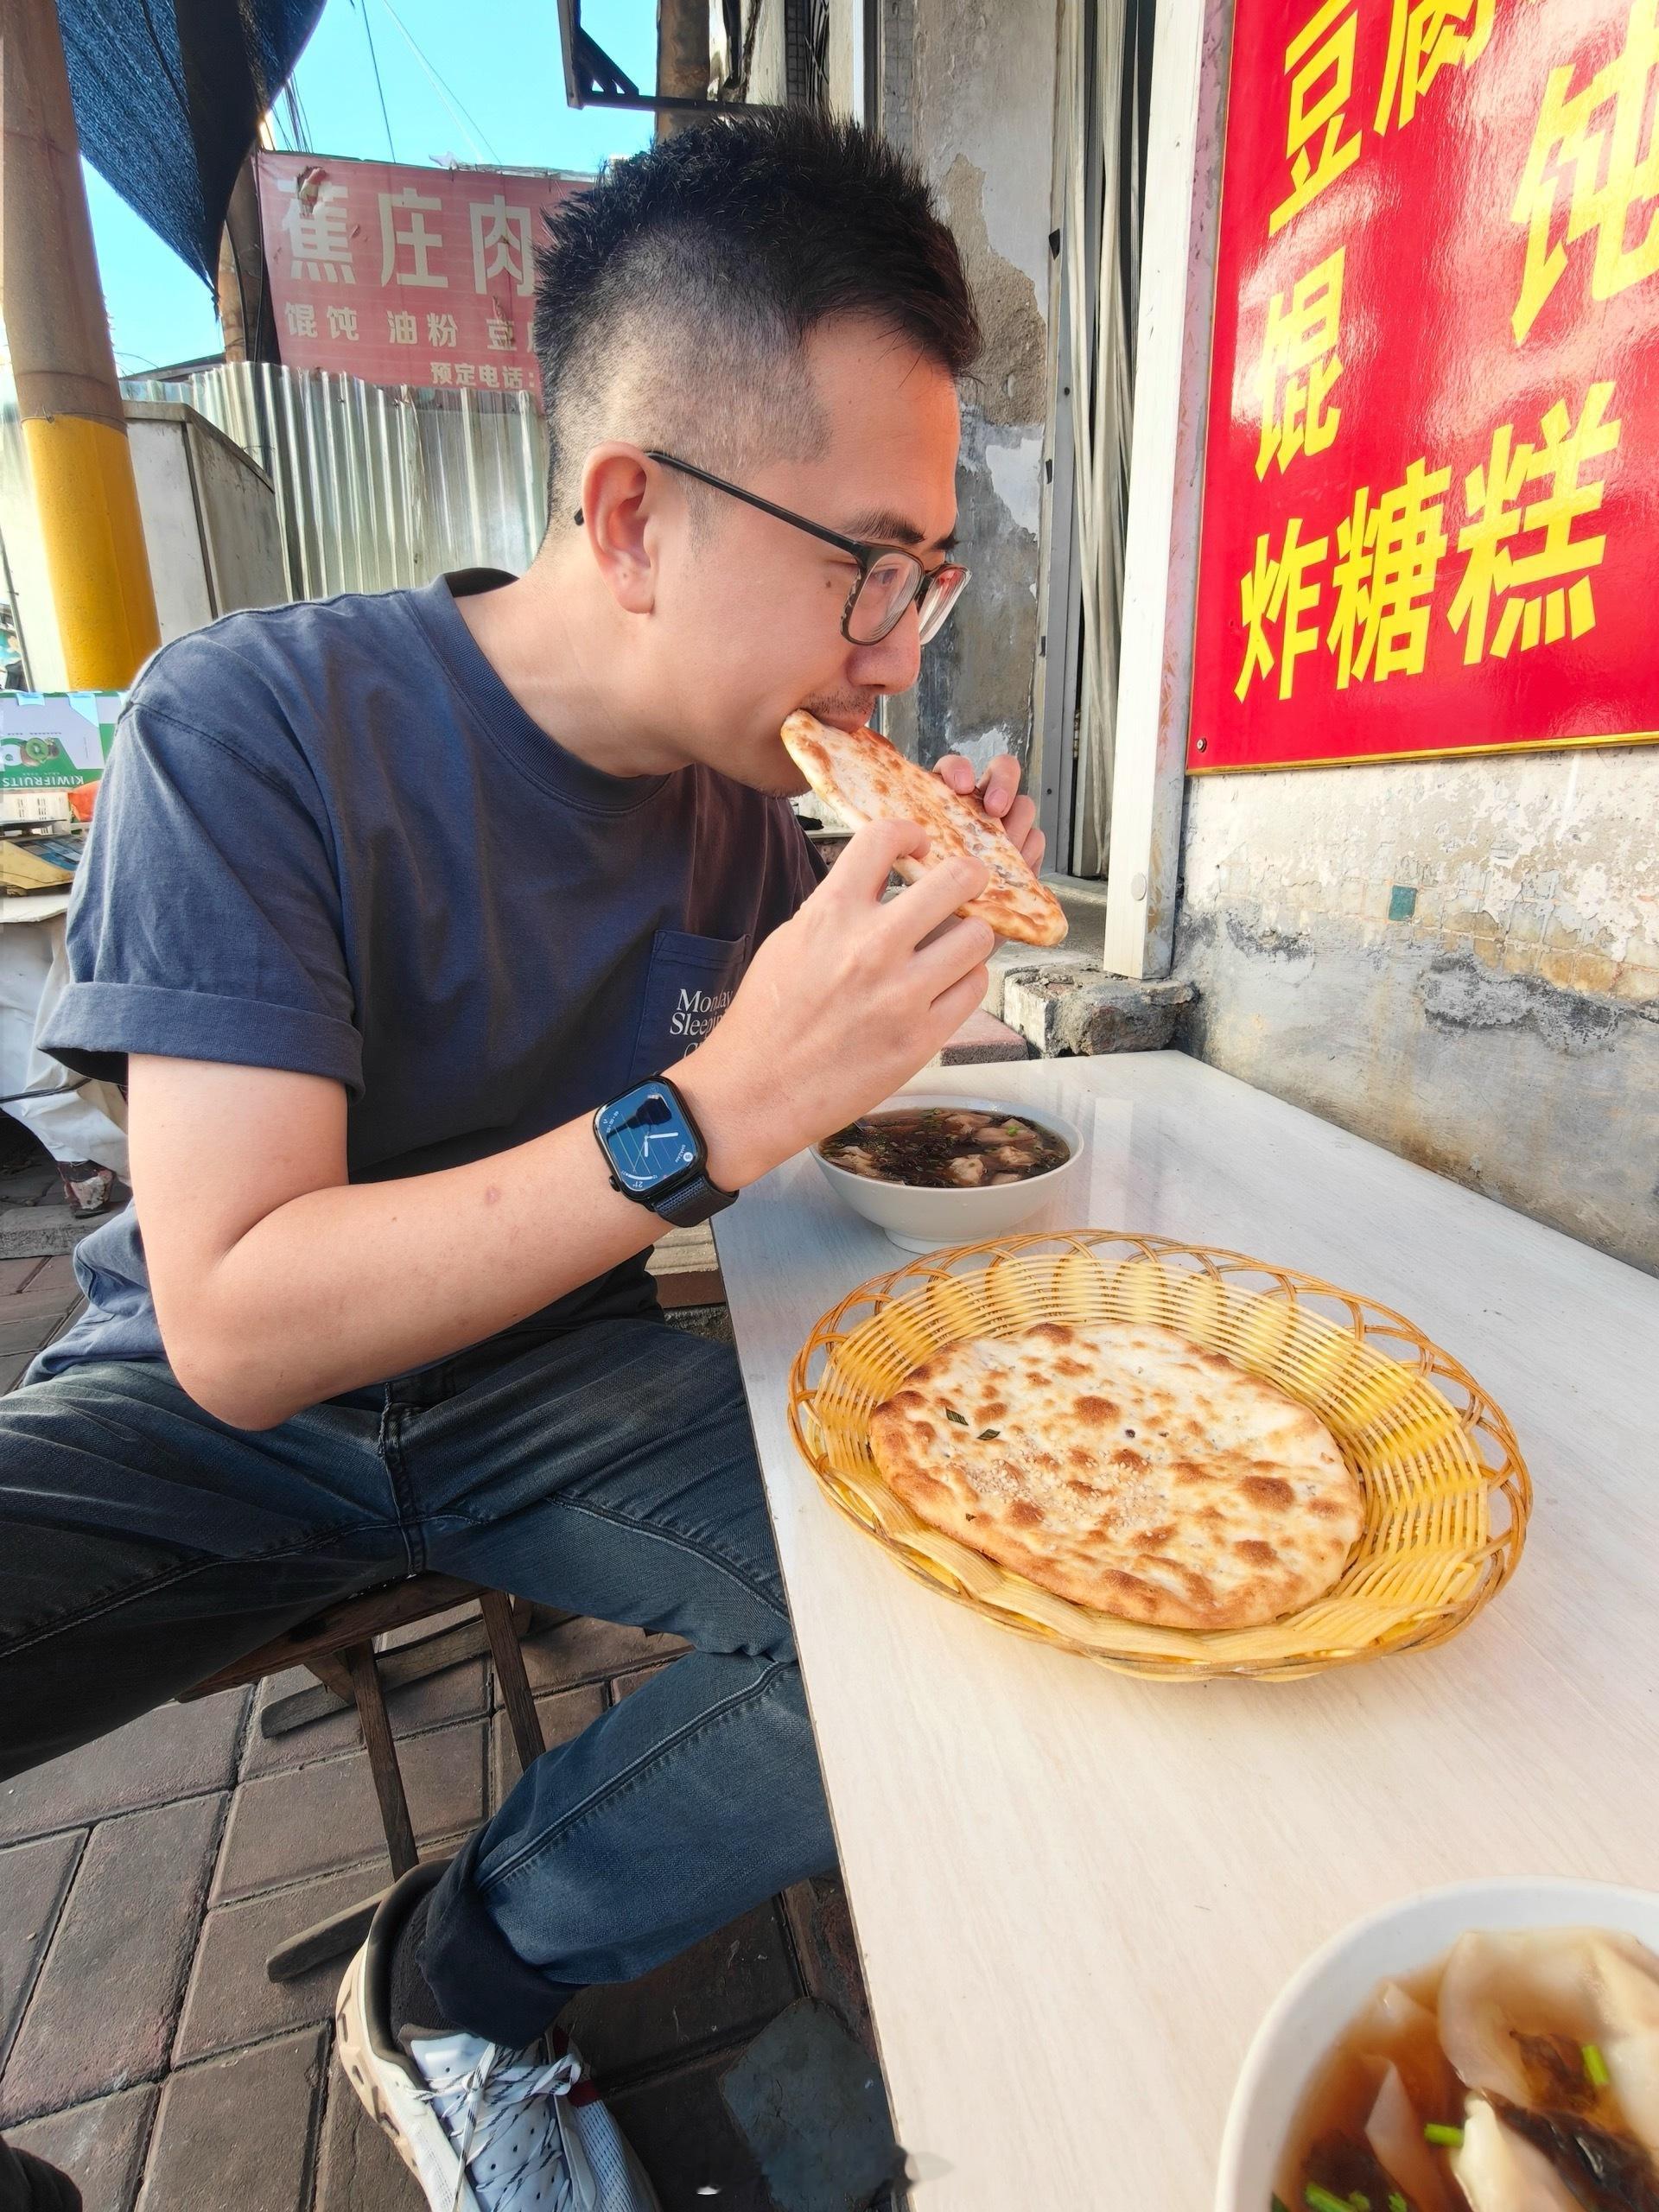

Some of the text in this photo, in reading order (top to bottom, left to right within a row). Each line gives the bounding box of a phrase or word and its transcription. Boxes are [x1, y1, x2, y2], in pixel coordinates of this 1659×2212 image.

[284, 302, 537, 353] 馄饨 油粉 豆
[1234, 380, 1619, 702] 炸糖糕
[3, 776, 84, 787] KIWIFRUITS
